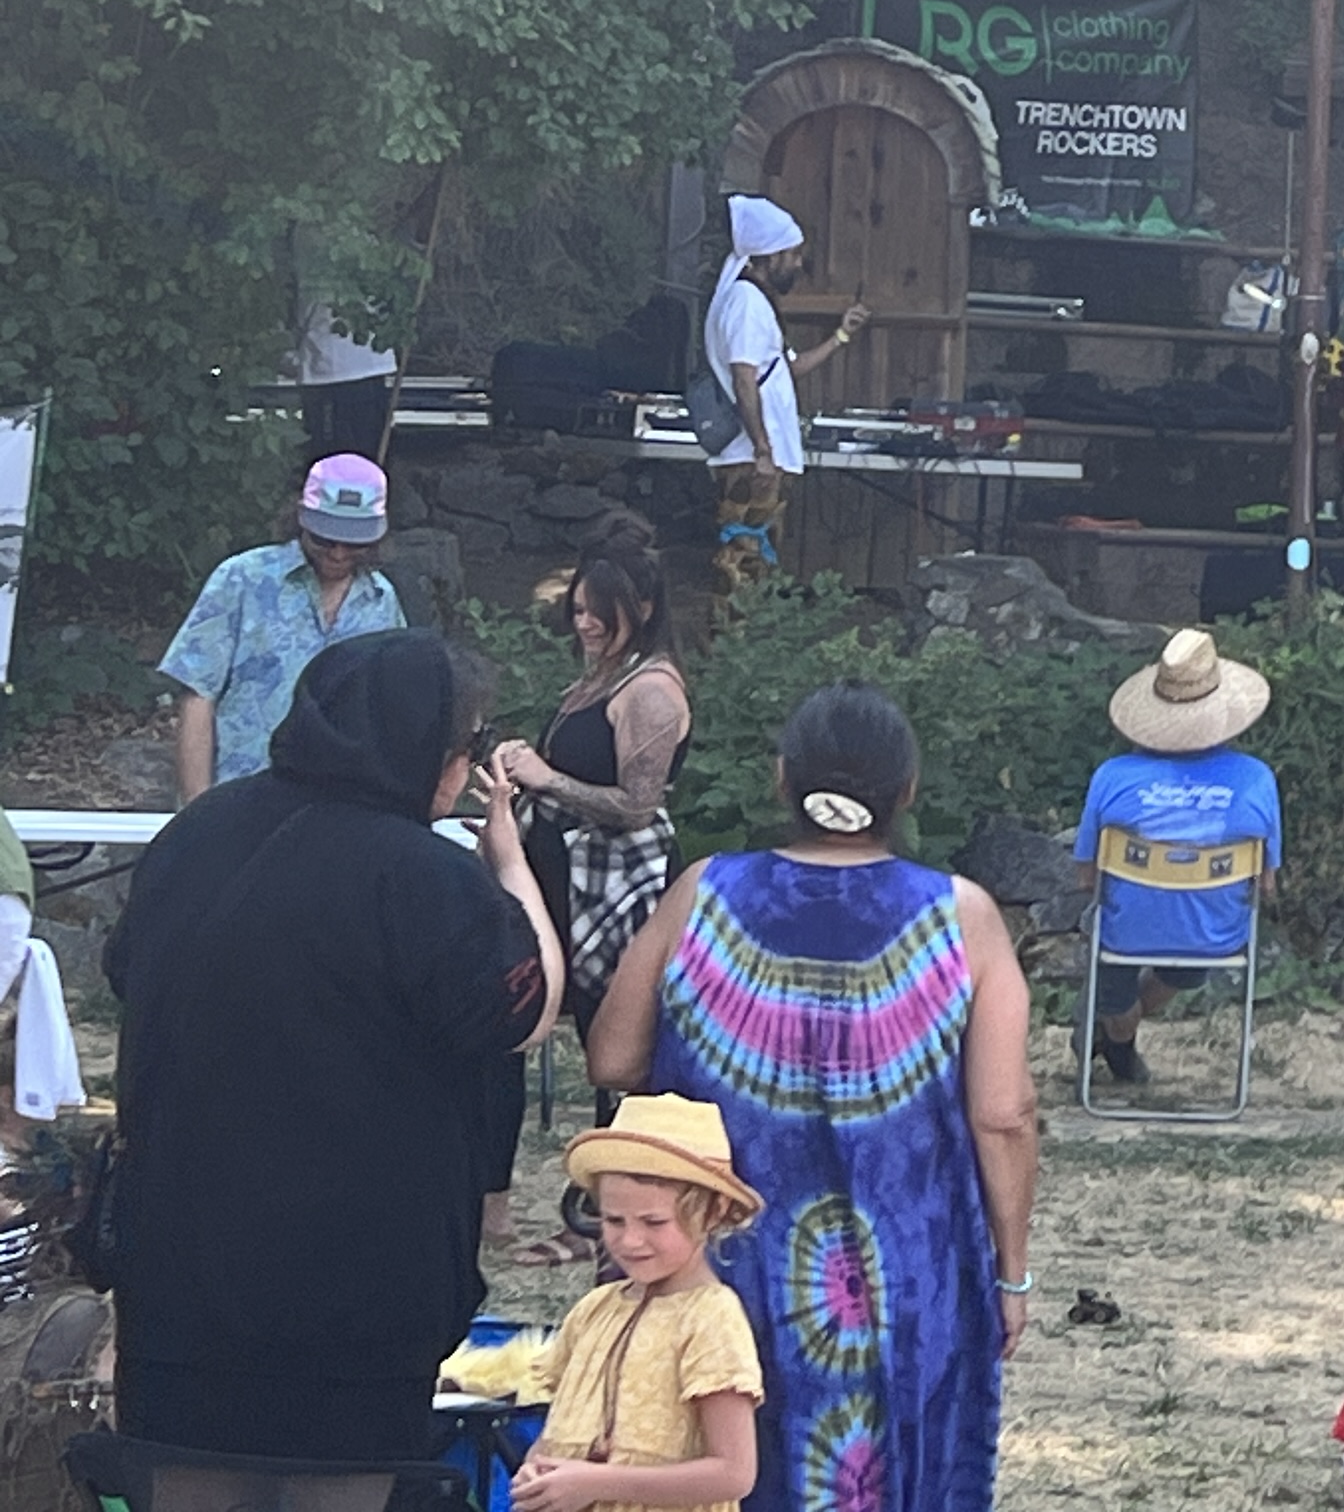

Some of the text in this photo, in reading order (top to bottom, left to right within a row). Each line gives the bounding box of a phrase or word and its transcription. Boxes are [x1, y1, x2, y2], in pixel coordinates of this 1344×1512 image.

[1053, 10, 1171, 49] clothing
[1057, 47, 1193, 85] company
[1016, 100, 1187, 132] TRENCHTOWN
[1036, 130, 1158, 158] ROCKERS
